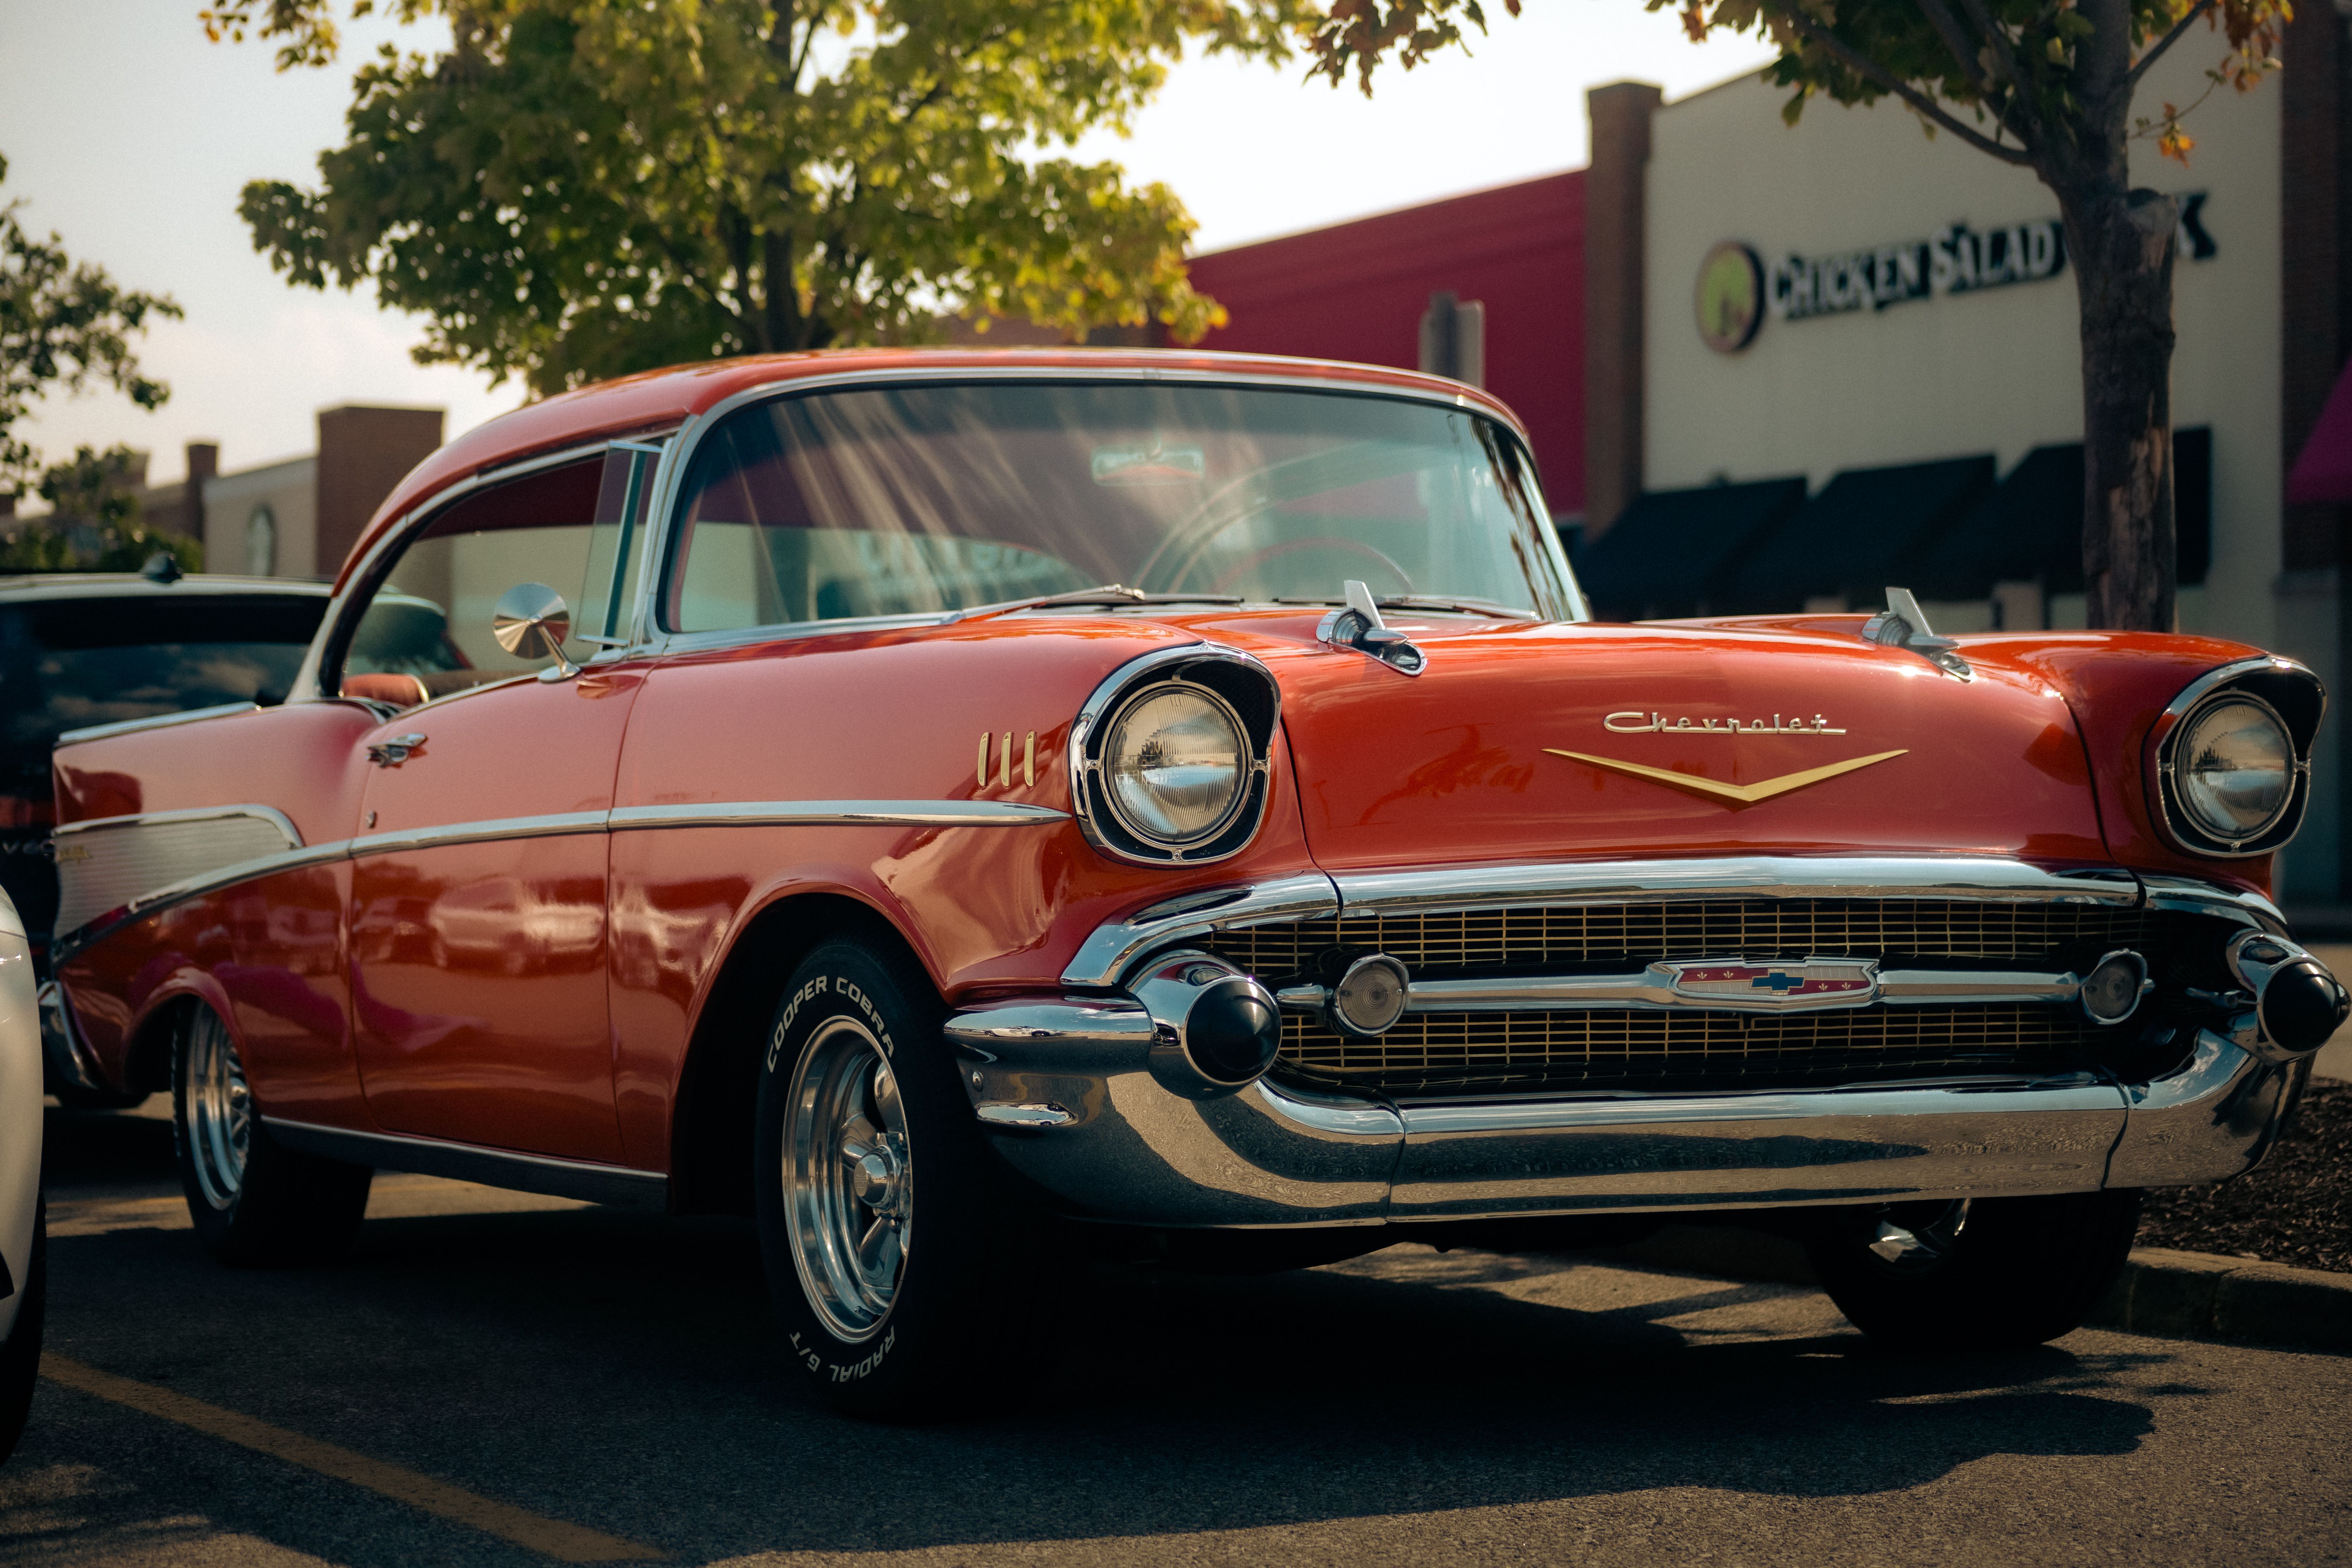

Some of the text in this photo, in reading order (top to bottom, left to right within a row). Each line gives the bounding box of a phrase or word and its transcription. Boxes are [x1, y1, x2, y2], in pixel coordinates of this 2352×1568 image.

[1767, 221, 2061, 319] CHICKEN SALAD
[1604, 711, 1847, 735] Chevrolet
[767, 975, 894, 1073] COOPER COBRA
[829, 1324, 895, 1382] RADIAL
